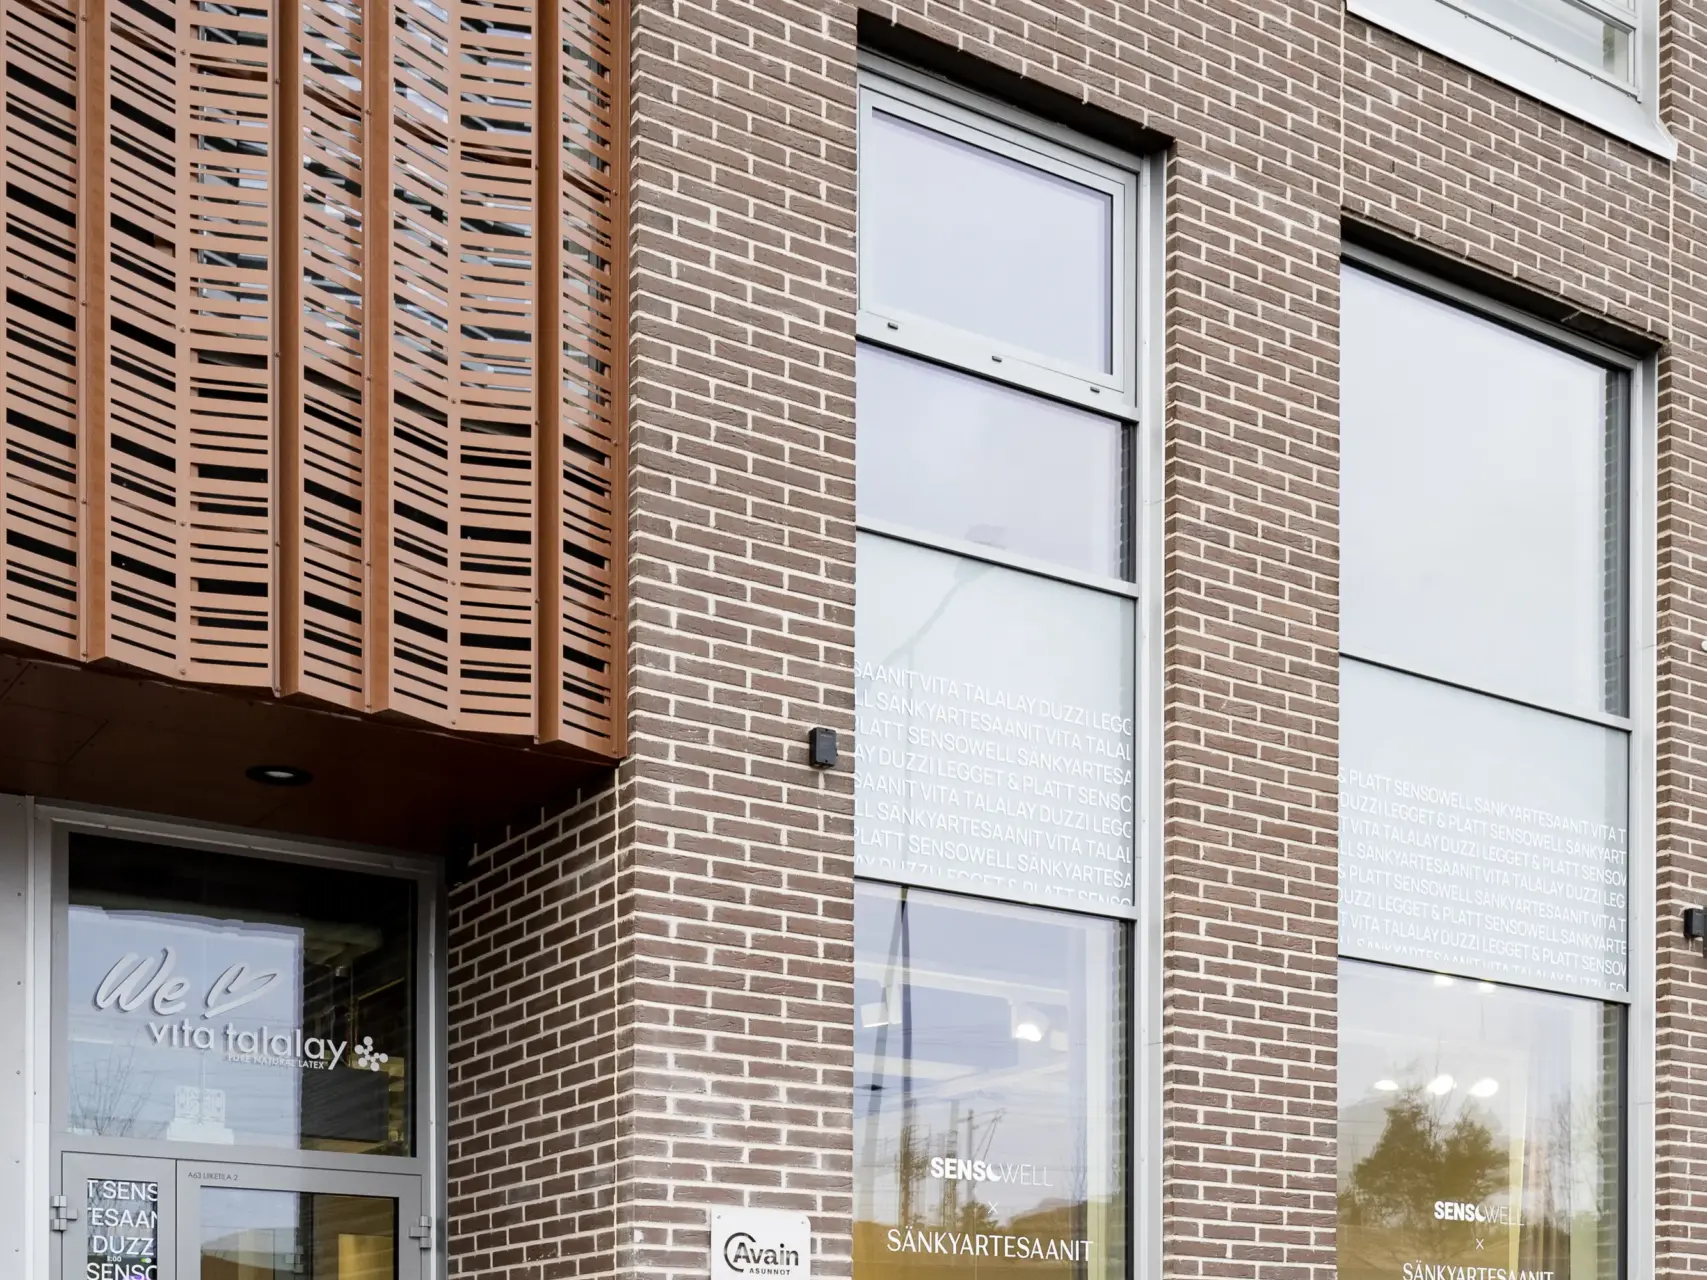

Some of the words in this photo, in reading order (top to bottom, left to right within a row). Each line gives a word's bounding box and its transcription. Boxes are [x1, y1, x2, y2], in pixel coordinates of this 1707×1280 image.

[919, 674, 959, 699] VITA
[962, 683, 1036, 714] TALALAY
[1040, 700, 1088, 726] DUZZI
[908, 726, 1016, 763] SENSOWELL
[1046, 726, 1082, 750] VITA
[880, 748, 932, 773] DUZZI
[938, 758, 1004, 787] LEGGET
[1008, 772, 1019, 790] &
[1023, 776, 1076, 802] PLATT
[920, 782, 960, 806] VITA
[963, 791, 1036, 820] TALALAY
[1040, 804, 1088, 830] DUZZI
[1340, 792, 1382, 816] DUZZI
[1384, 802, 1436, 826] LEGGET
[1437, 812, 1446, 828] &
[1448, 816, 1488, 836] PLATT
[1490, 824, 1564, 852] SENSOWELL
[1350, 770, 1391, 793] PLATT
[1394, 781, 1472, 811] SENSOWELL
[1590, 824, 1616, 842] VITA
[908, 834, 1016, 870] SENSOWELL
[1046, 832, 1082, 855] VITA
[1350, 818, 1380, 838] VITA
[1383, 824, 1440, 847] TALALAY
[1442, 837, 1479, 858] DUZZI
[1482, 844, 1530, 867] LEGGET
[1532, 854, 1540, 870] &
[1542, 857, 1580, 878] PLATT
[1350, 865, 1392, 887] PLATT
[1394, 874, 1472, 904] SENSOWELL
[1591, 913, 1616, 932] VITA
[1483, 867, 1510, 886] VITA
[1512, 873, 1565, 897] TALALAY
[1566, 884, 1600, 904] DUZZI
[1604, 890, 1625, 908] LEG
[1350, 914, 1380, 932] VITA
[1383, 920, 1440, 944] TALALAY
[1441, 930, 1479, 950] DUZZI
[1482, 936, 1530, 960] LEGGET
[1532, 946, 1540, 962] &
[1542, 950, 1580, 970] PLATT
[1378, 894, 1430, 918] LEGGET
[1431, 904, 1440, 920] &
[1443, 907, 1484, 928] PLATT
[1484, 915, 1560, 942] SENSOWELL
[94, 946, 190, 1016] We
[148, 1018, 214, 1050] vita
[226, 1022, 347, 1070] talalay
[93, 1236, 154, 1256] DUZZ
[887, 1226, 1094, 1262] SÄNKYARTESAANIT
[750, 1268, 790, 1276] ASUNNOT
